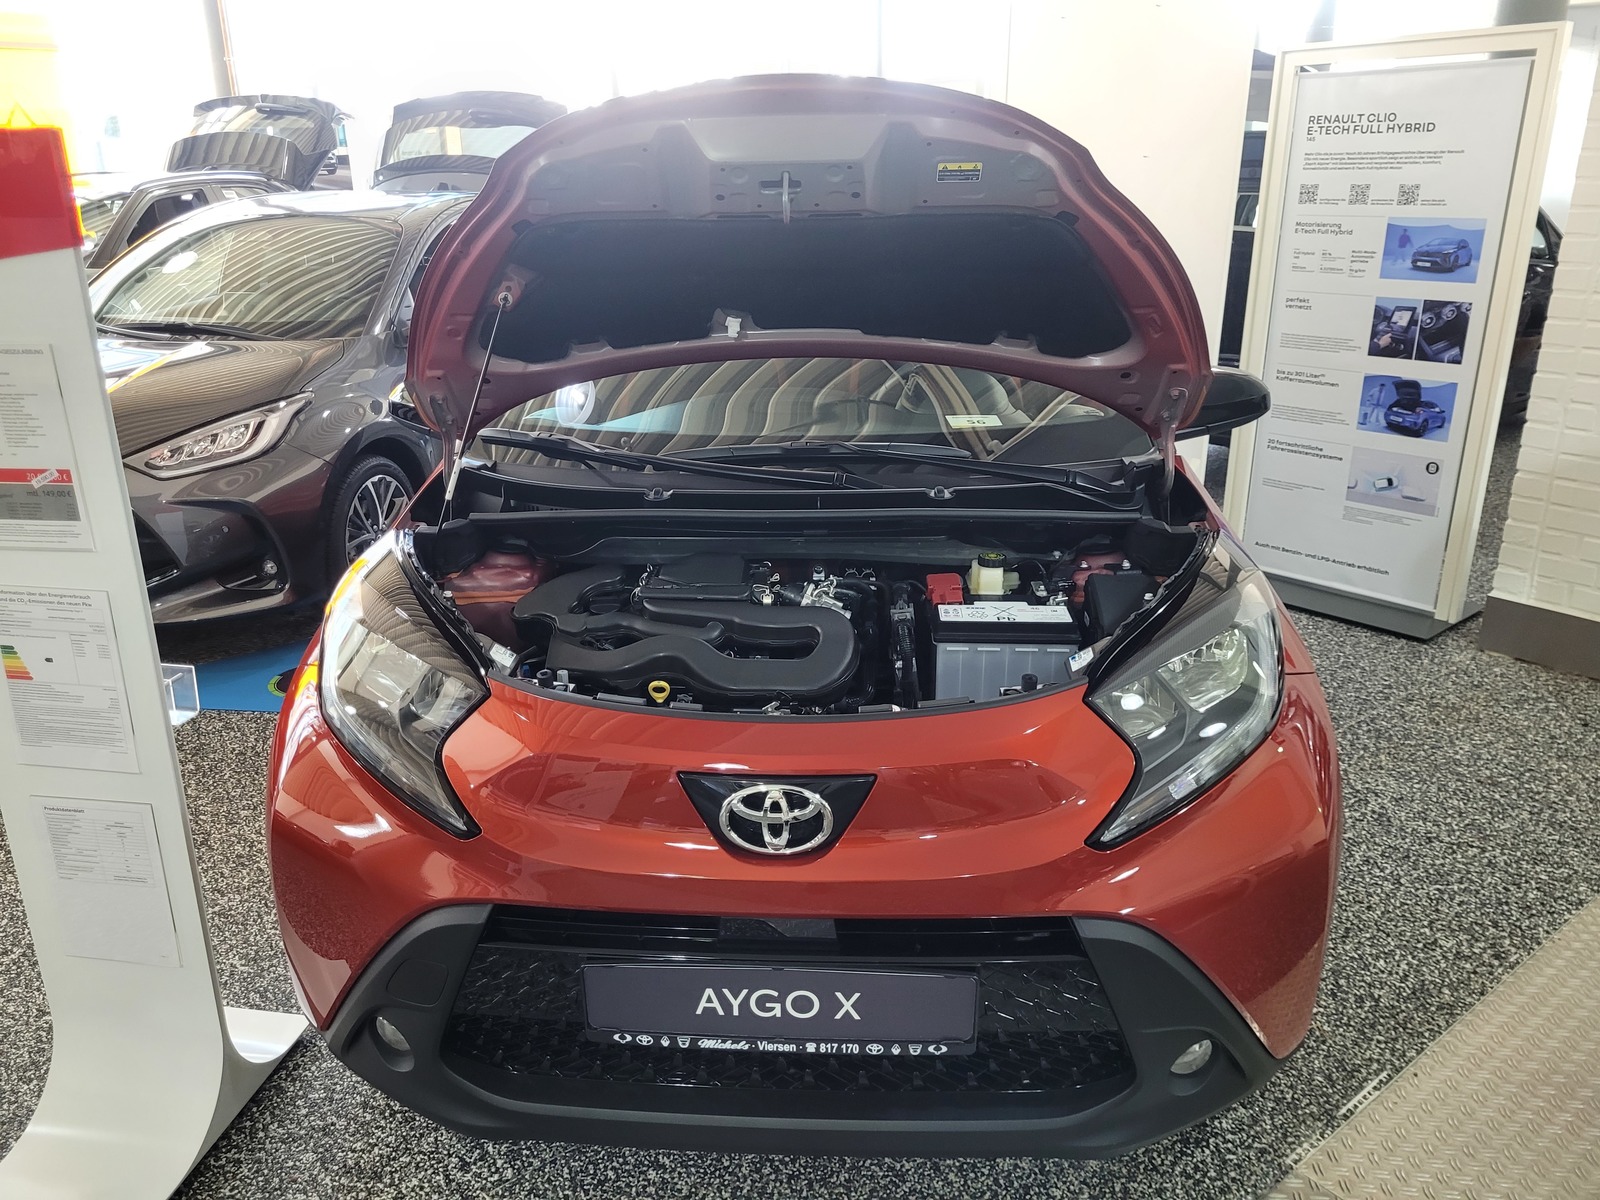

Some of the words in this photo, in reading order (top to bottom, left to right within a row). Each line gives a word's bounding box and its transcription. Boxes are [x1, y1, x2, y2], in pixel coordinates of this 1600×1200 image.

[1308, 114, 1365, 125] RENAULT
[1366, 112, 1397, 123] CLIO
[1306, 125, 1350, 136] E-TECH
[1352, 124, 1384, 134] FULL
[1386, 122, 1436, 134] HYBRID
[1295, 221, 1342, 229] Motorisierung
[1330, 229, 1353, 237] Hybrid
[1254, 541, 1270, 549] Auch
[695, 987, 820, 1019] AYGO
[833, 991, 862, 1020] X
[697, 1038, 750, 1050] Michels
[757, 1040, 797, 1052] Viersen
[819, 1042, 838, 1053] 817
[840, 1042, 859, 1054] 170
